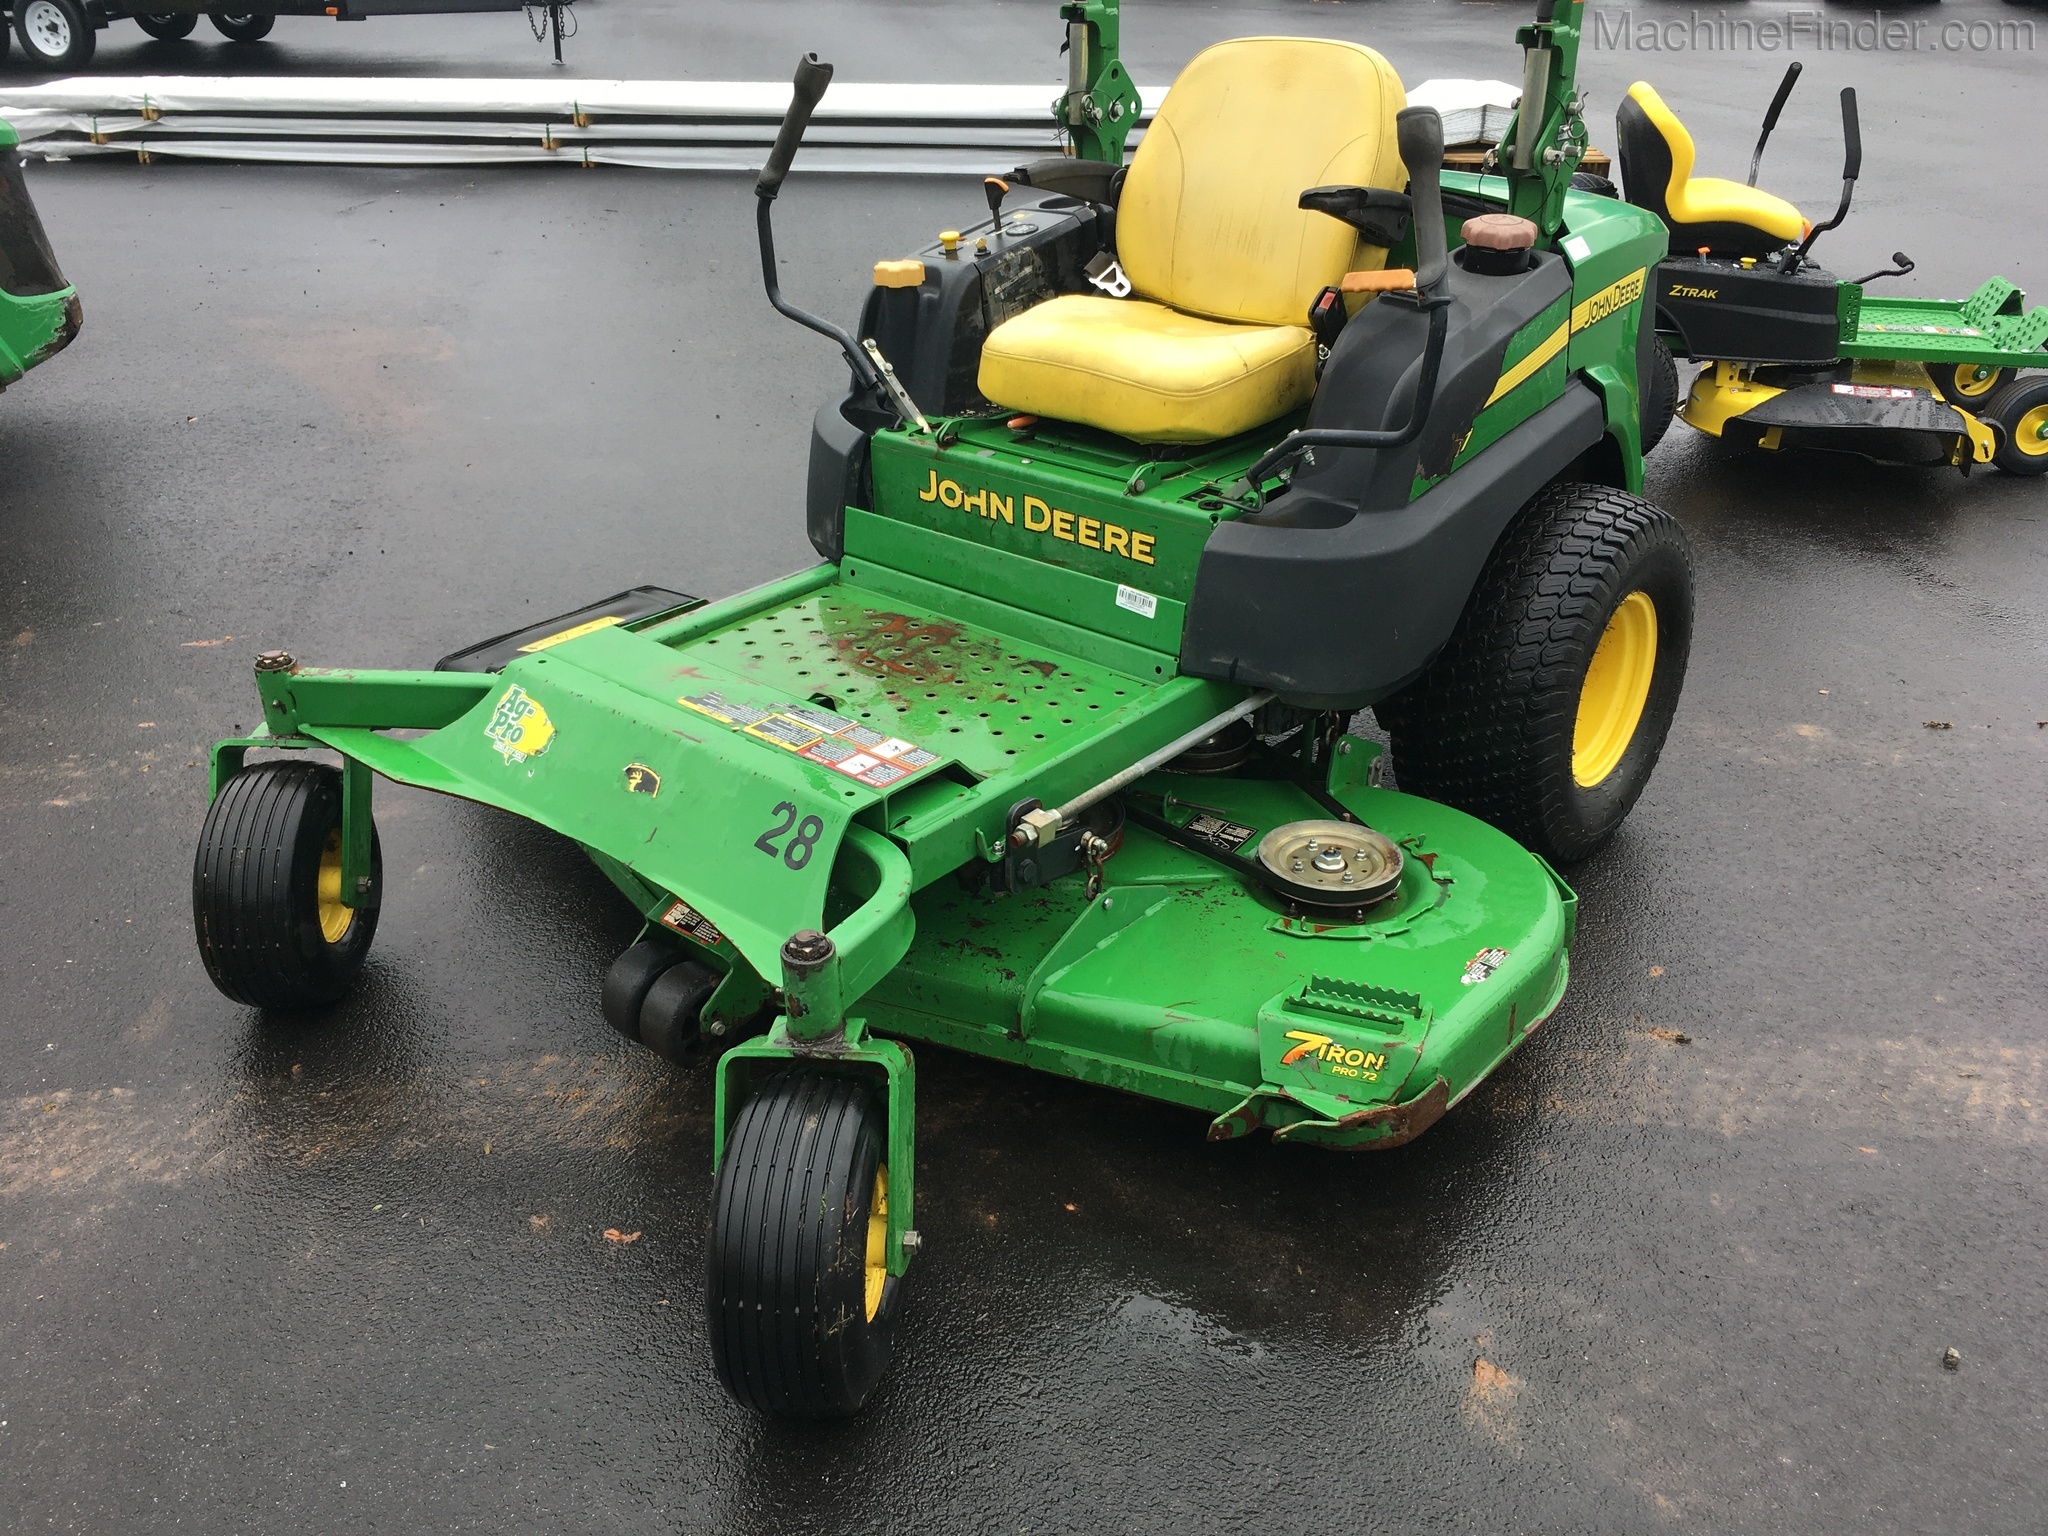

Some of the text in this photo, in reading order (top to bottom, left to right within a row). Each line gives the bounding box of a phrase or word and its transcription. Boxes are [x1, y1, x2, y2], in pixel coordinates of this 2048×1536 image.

[1585, 278, 1641, 328] JOHN DEERE
[1668, 284, 1719, 299] ZTRAK
[919, 469, 1157, 566] JOHN DEERE
[487, 711, 525, 745] Pro
[753, 800, 824, 871] 28
[1331, 1065, 1378, 1082] PRO 72
